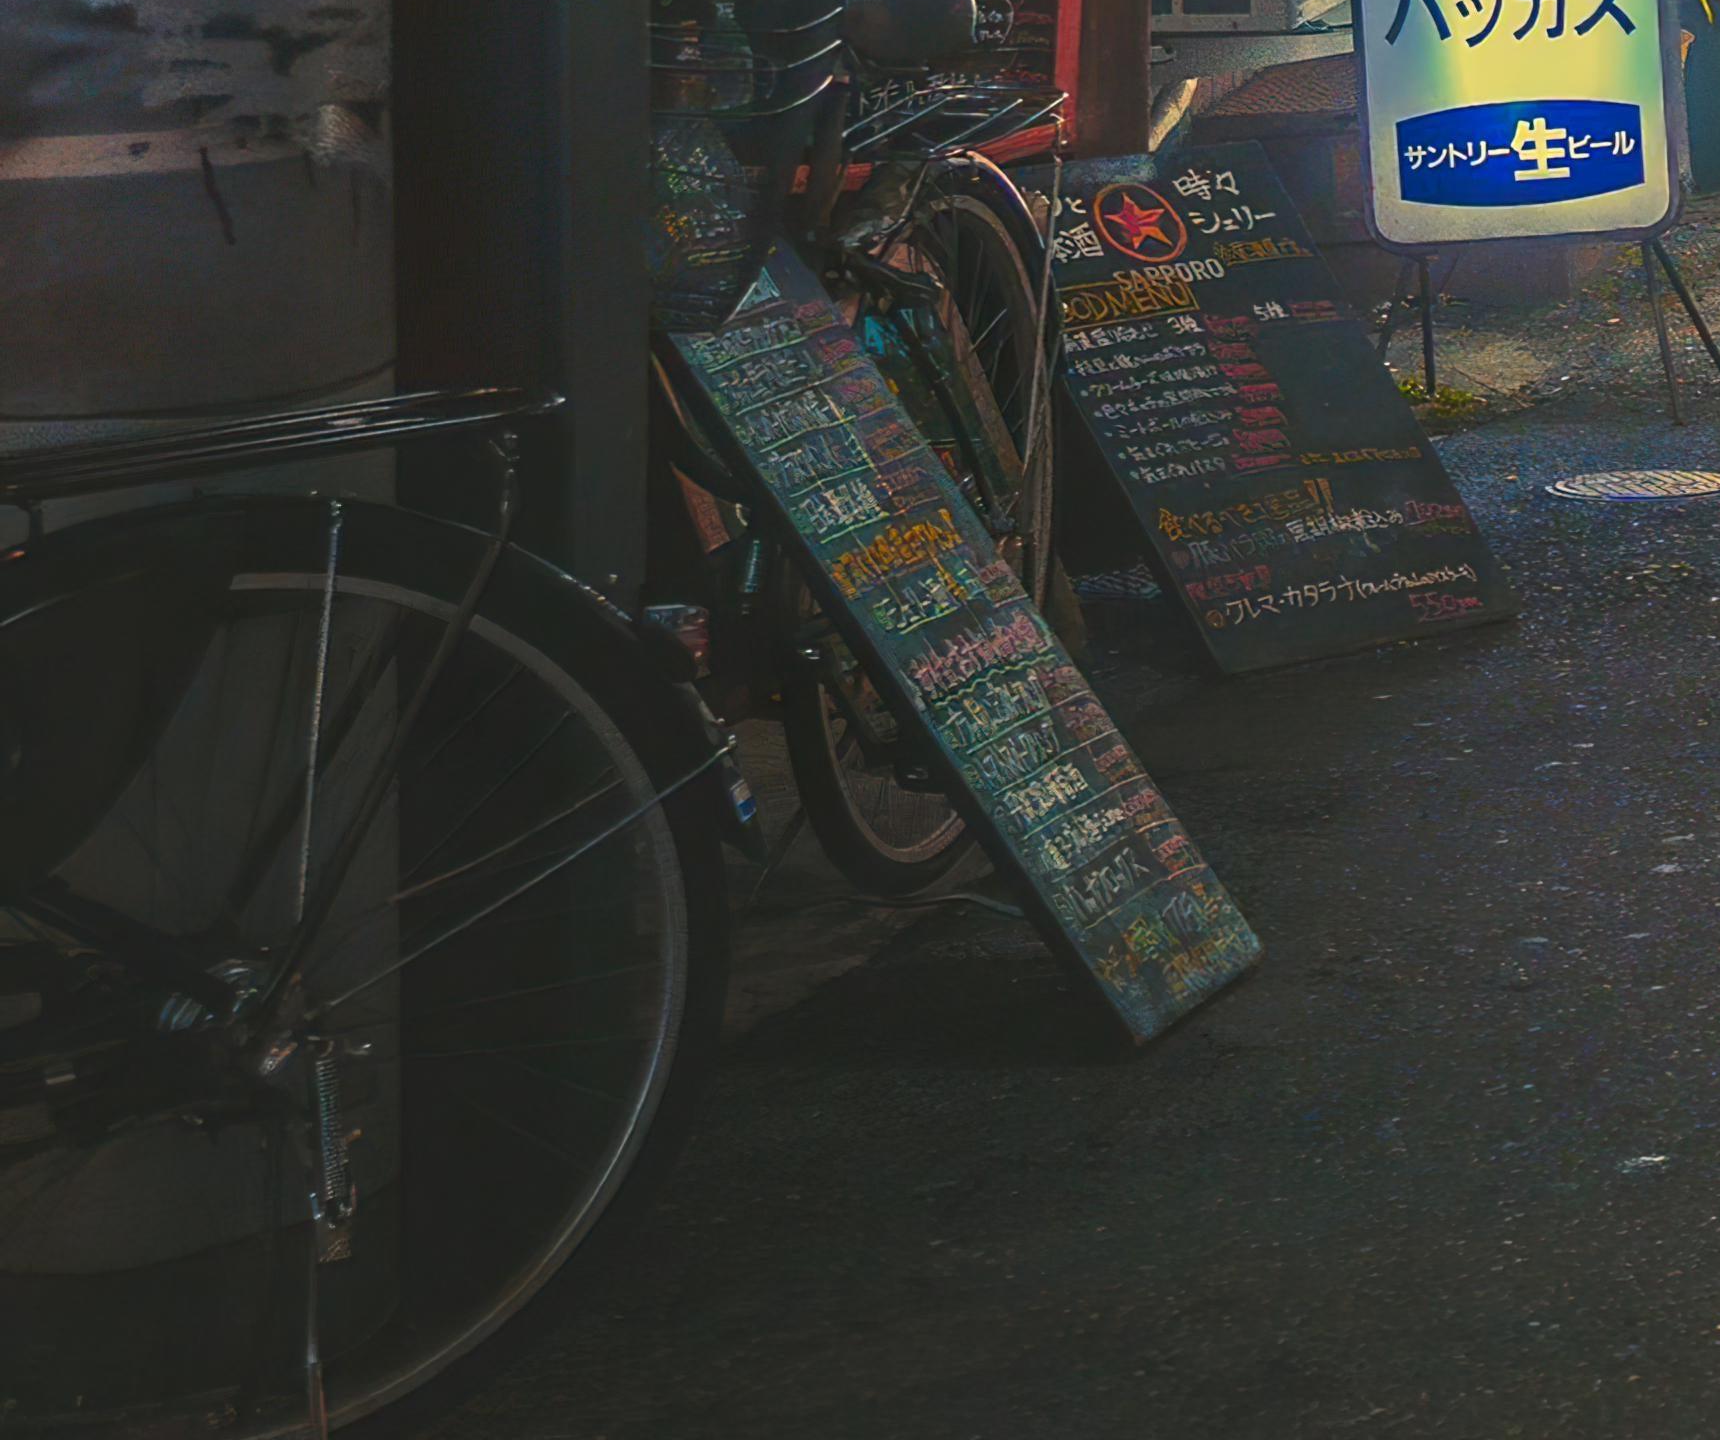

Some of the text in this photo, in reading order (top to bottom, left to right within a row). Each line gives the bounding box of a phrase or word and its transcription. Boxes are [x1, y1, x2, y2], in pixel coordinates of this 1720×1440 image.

[1404, 117, 1635, 182] サントリー生ビール
[1172, 168, 1240, 200] 時々
[1189, 205, 1277, 236] シェリー
[1112, 257, 1225, 292] SAPPORO
